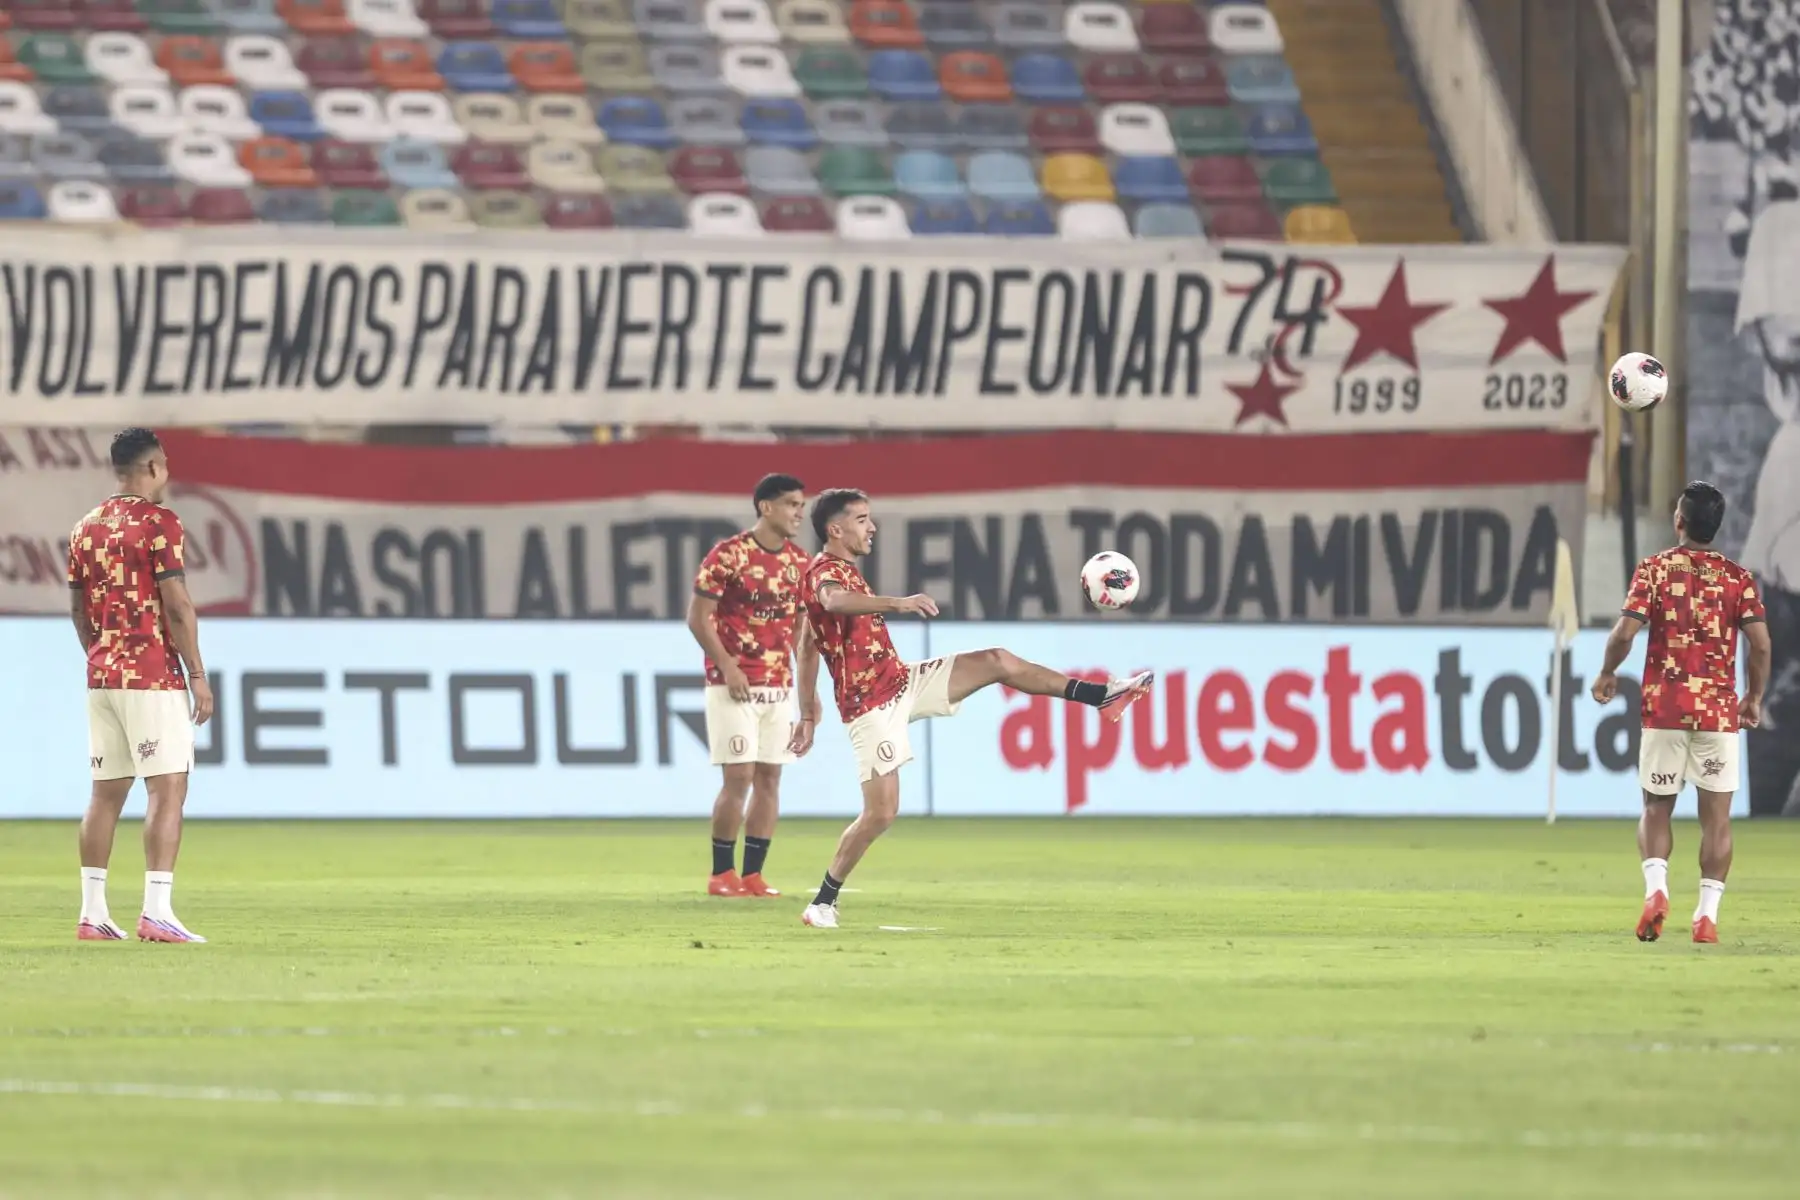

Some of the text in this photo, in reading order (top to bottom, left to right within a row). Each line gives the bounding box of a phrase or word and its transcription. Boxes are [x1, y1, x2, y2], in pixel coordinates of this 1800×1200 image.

[2, 261, 1212, 397] VOLVEREMOS PARA VERTE CAMPEONAR
[1221, 250, 1330, 356] 74
[1333, 375, 1421, 415] 1999
[1483, 373, 1568, 410] 2023
[1068, 509, 1282, 618] TODA
[1291, 511, 1370, 617] MI
[1380, 505, 1562, 615] VIDA
